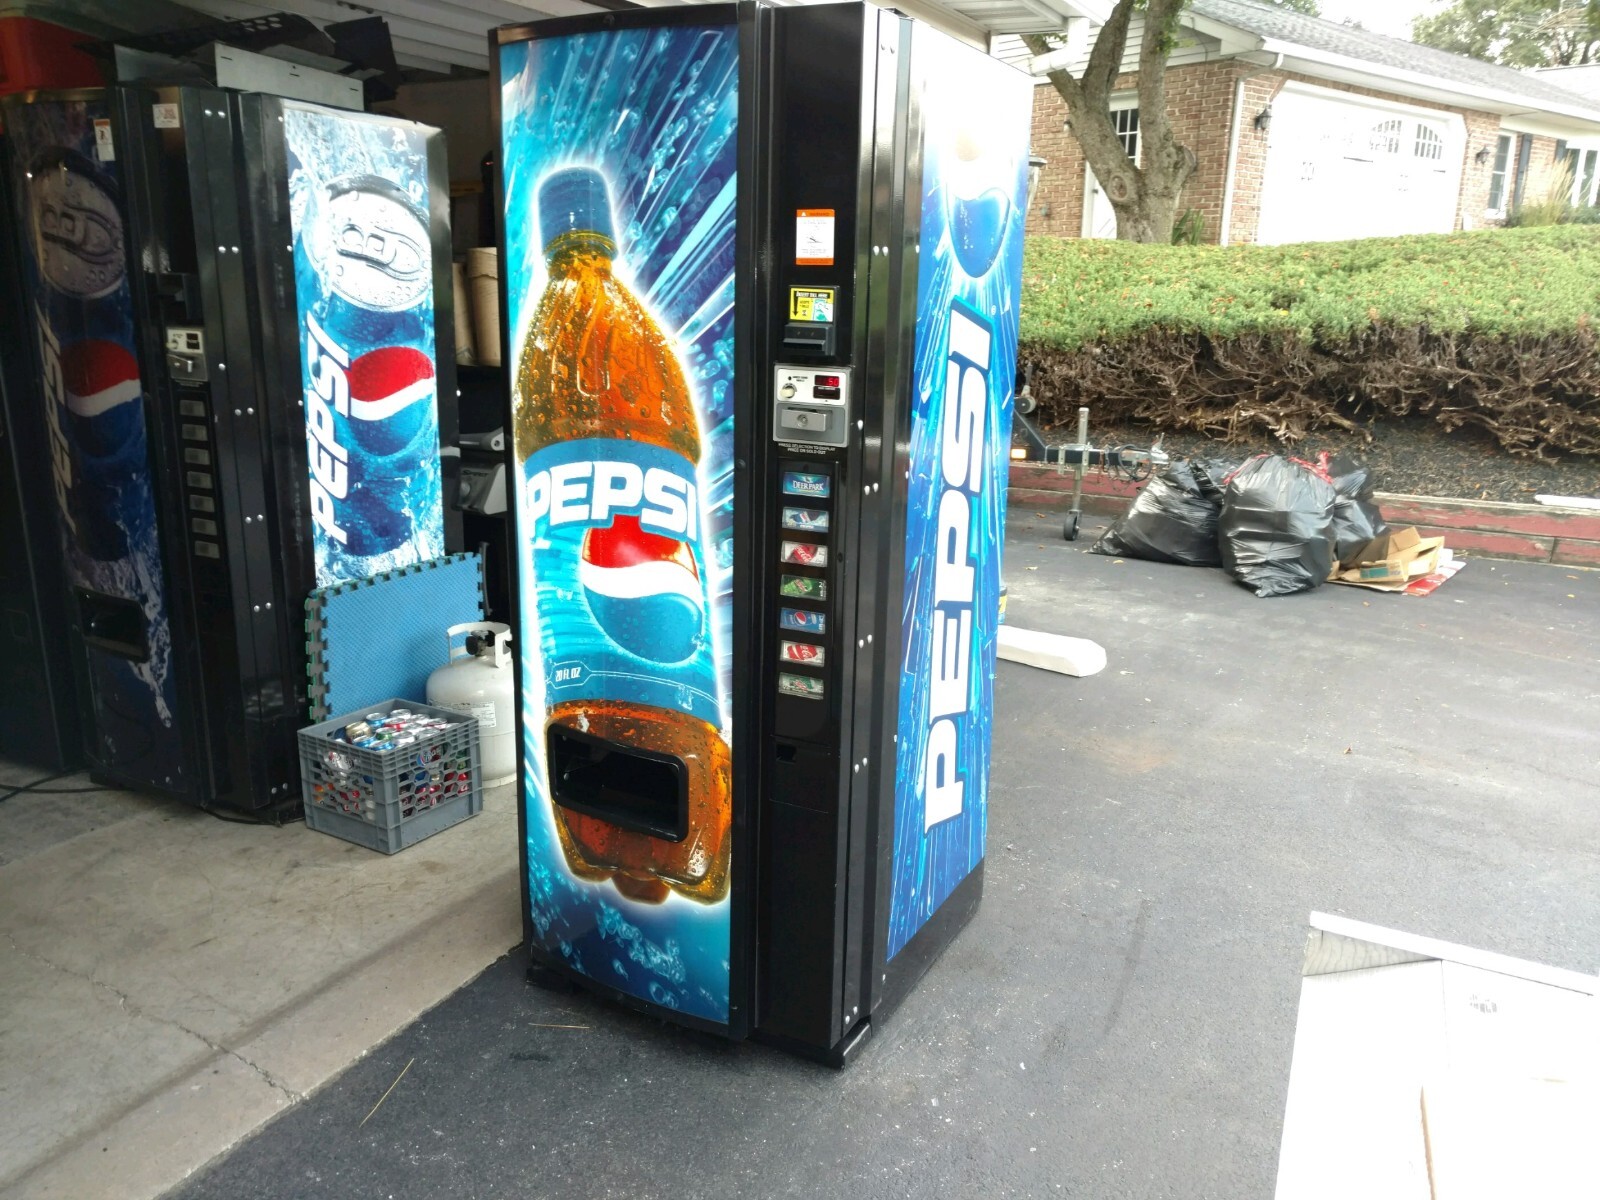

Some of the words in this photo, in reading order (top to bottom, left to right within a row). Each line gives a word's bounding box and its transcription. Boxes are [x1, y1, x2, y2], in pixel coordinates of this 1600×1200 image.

[306, 311, 351, 545] PEPSI
[526, 461, 697, 541] PEPSI
[793, 480, 809, 490] DEER
[809, 482, 824, 491] PARK
[926, 308, 990, 834] PEPSI
[555, 669, 563, 682] 20
[563, 667, 570, 680] FL
[571, 666, 581, 679] OZ
